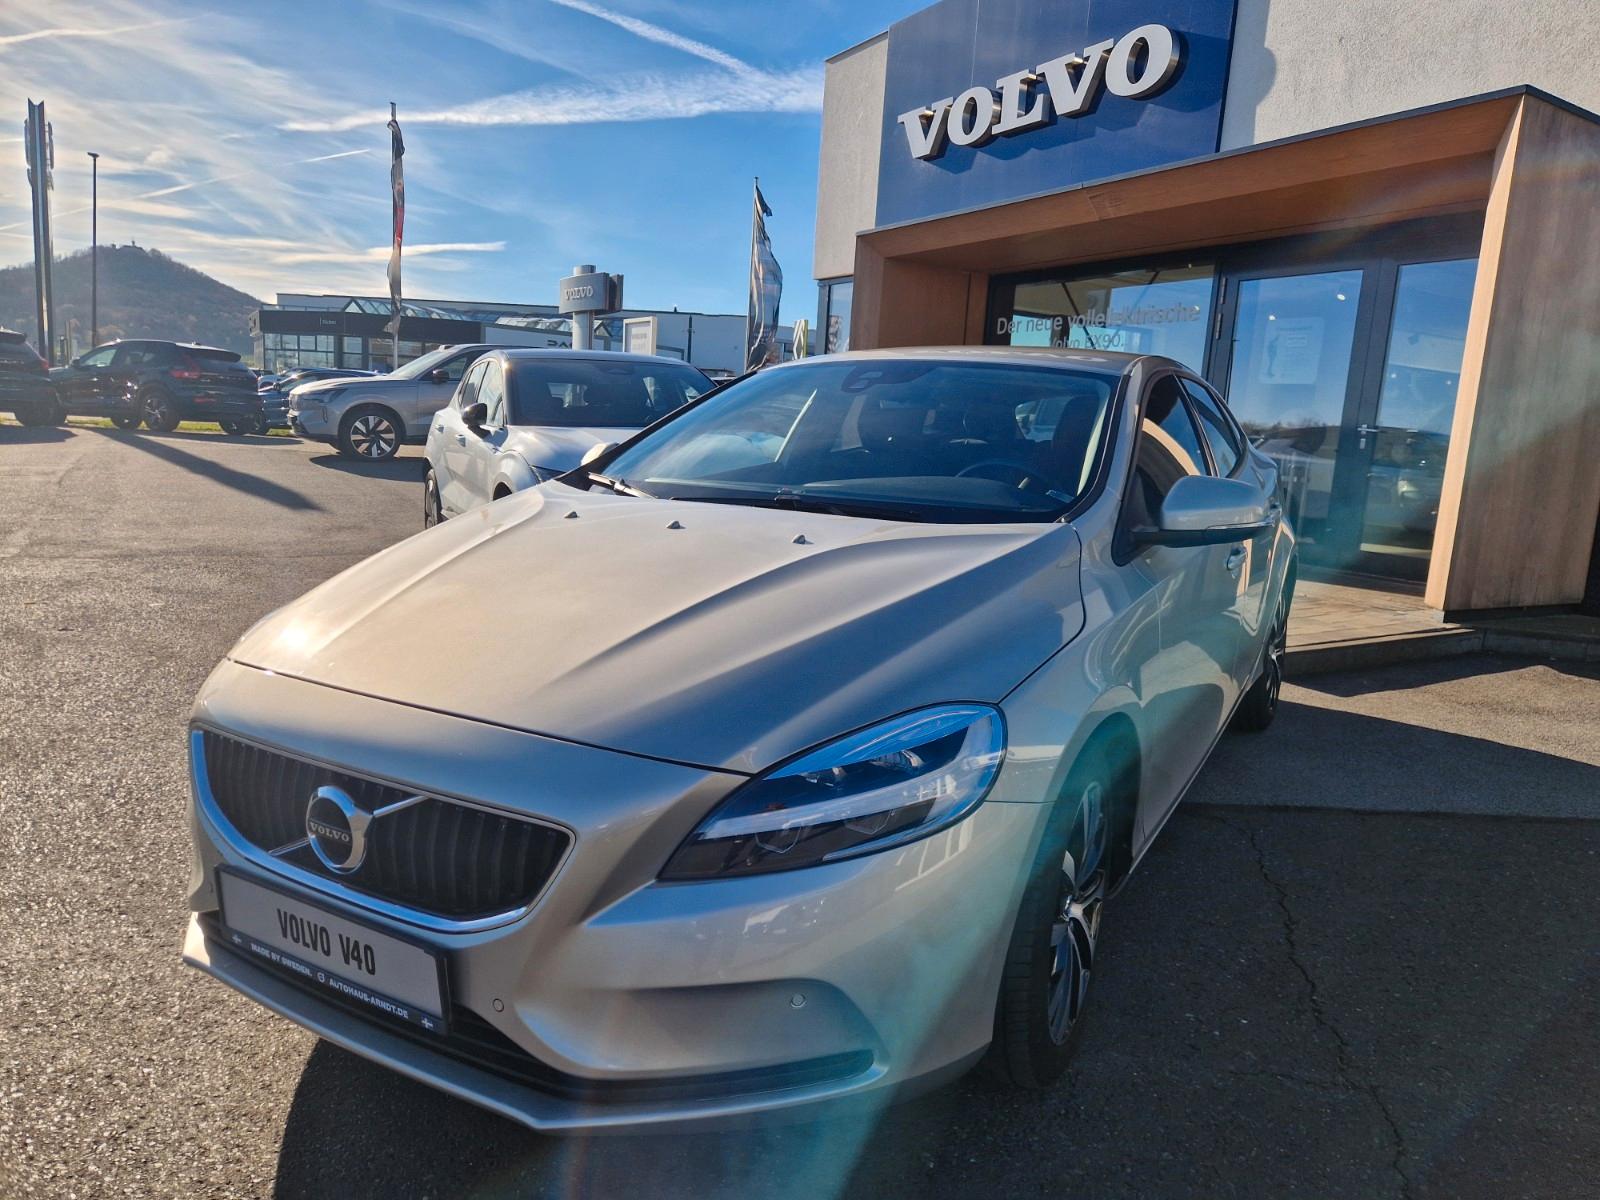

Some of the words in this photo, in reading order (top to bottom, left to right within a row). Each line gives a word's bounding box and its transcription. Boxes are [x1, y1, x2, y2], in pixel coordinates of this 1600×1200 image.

[897, 23, 1175, 159] VOLVO
[565, 286, 594, 300] VOLVO
[996, 317, 1023, 335] Der
[1025, 315, 1063, 334] neue
[310, 822, 350, 842] VOLVO
[276, 908, 331, 957] VOLVO
[339, 933, 376, 976] V40
[251, 943, 271, 959] MADE
[271, 951, 281, 963] BY
